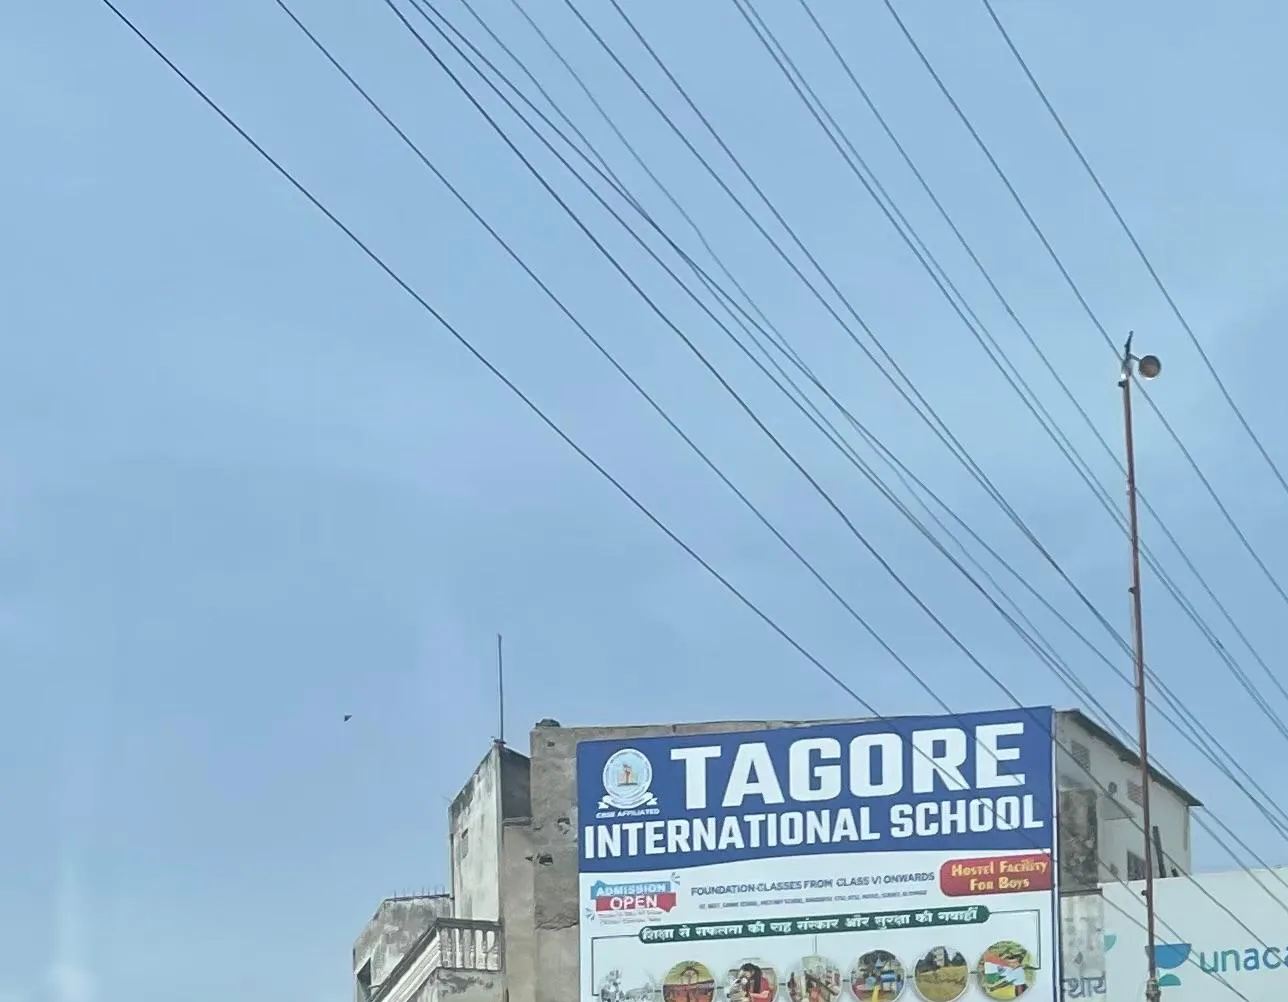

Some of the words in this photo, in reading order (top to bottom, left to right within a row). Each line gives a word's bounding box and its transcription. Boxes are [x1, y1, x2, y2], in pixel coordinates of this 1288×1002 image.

[670, 722, 1026, 810] TAGORE
[584, 808, 881, 859] INTERNATIONAL
[890, 794, 1044, 838] SCHOOL
[609, 894, 659, 911] OPEN
[691, 884, 755, 897] FOUNDATION
[757, 880, 802, 892] CLASSES
[804, 878, 834, 890] FROM
[836, 875, 870, 887] CLASS
[884, 872, 935, 884] ONWARDS
